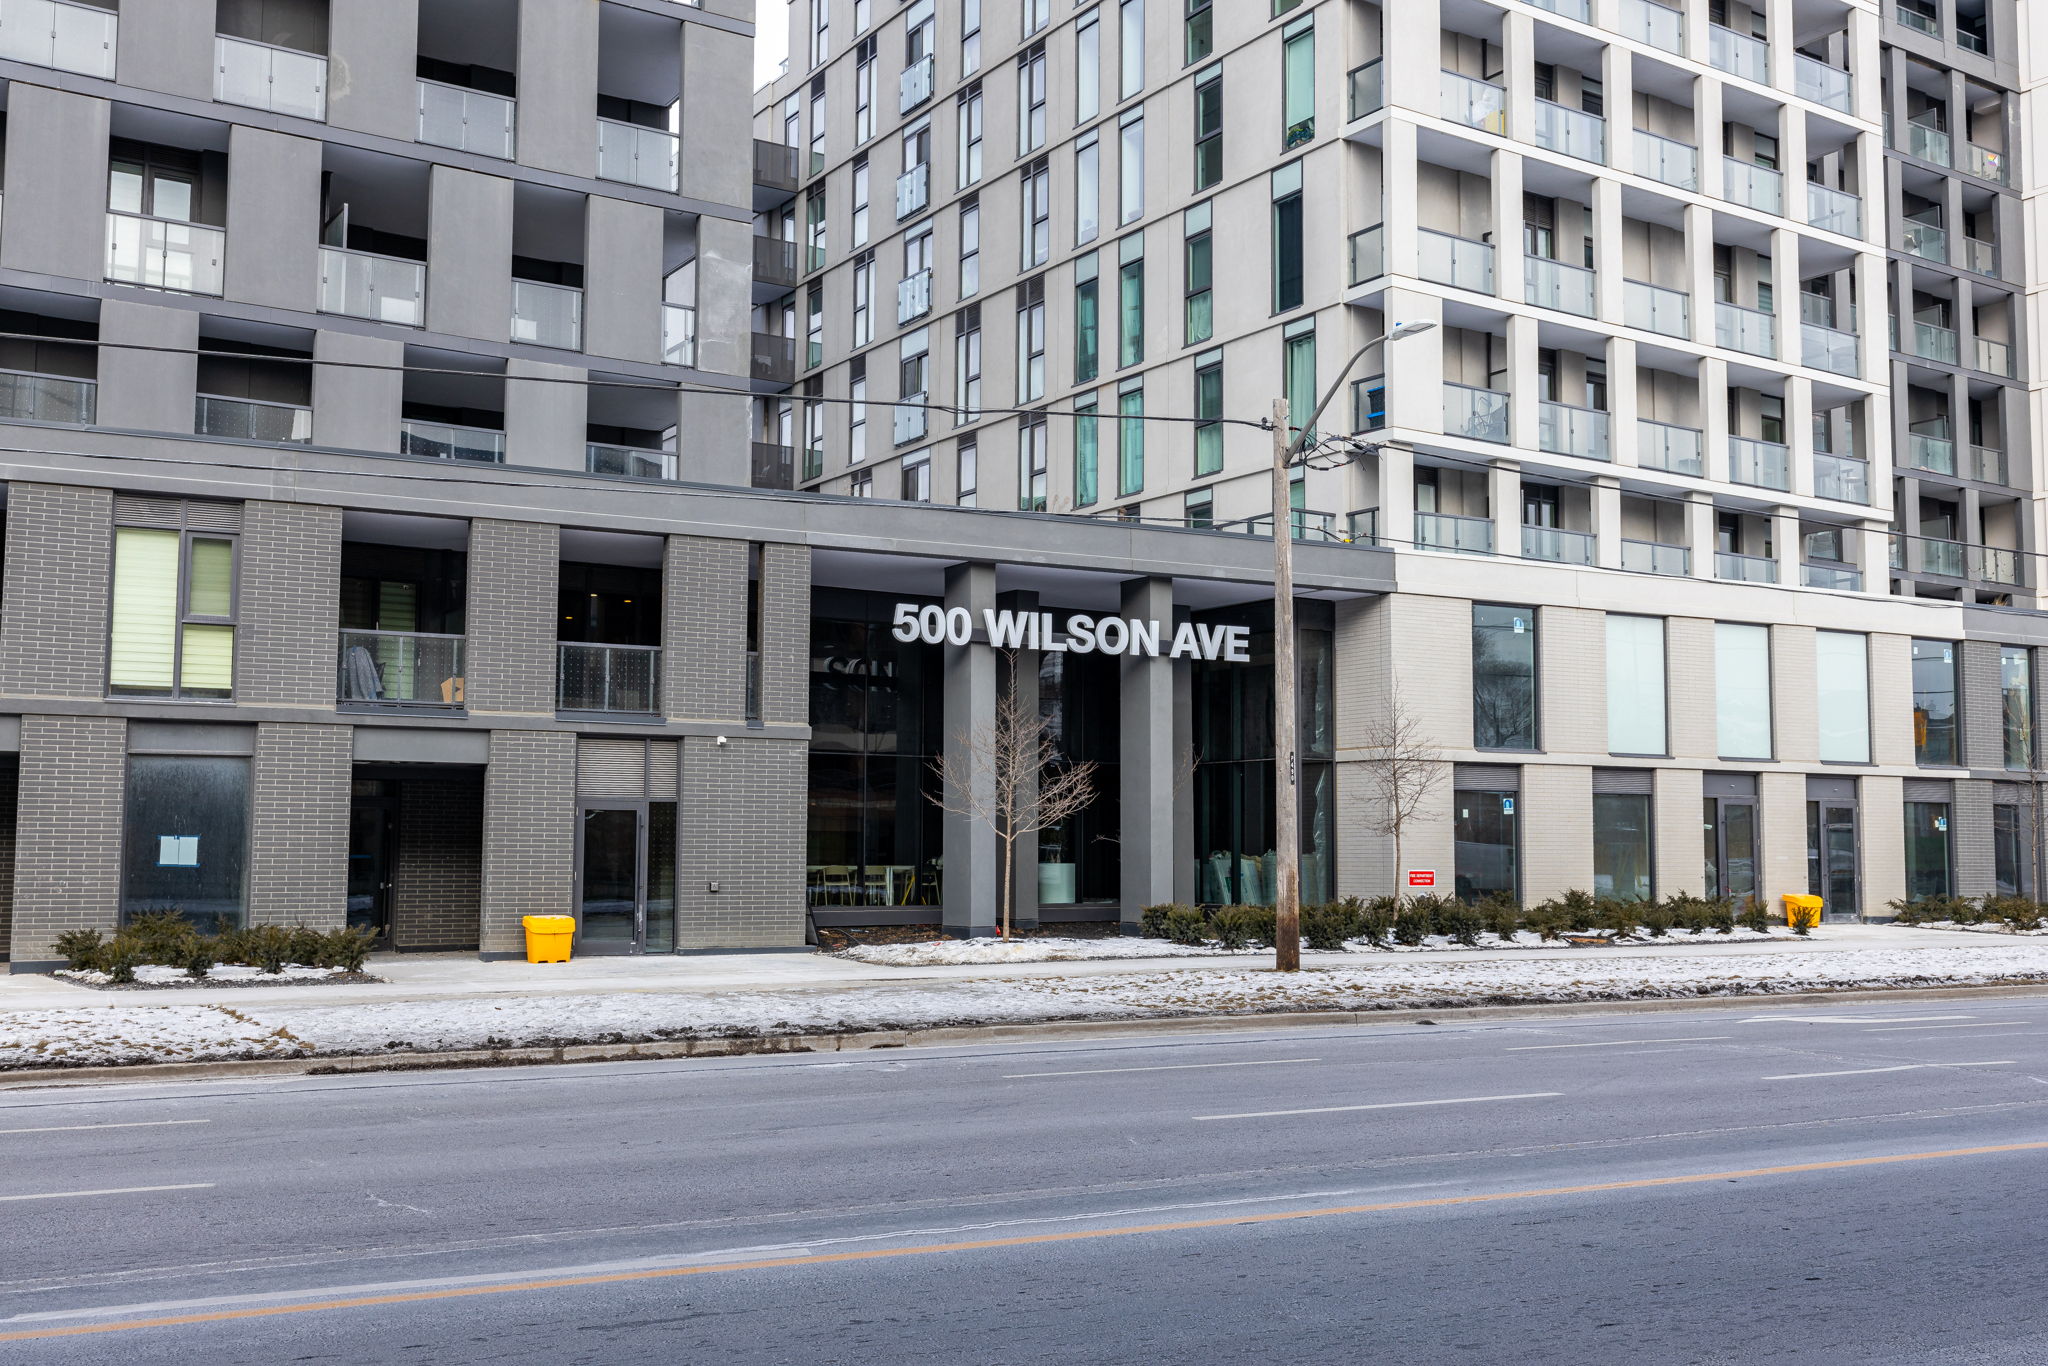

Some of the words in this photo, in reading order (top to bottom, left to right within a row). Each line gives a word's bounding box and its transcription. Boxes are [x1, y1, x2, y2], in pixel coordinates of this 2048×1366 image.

[892, 603, 972, 646] 500
[983, 608, 1160, 657] WILSON
[1169, 622, 1250, 662] AVE
